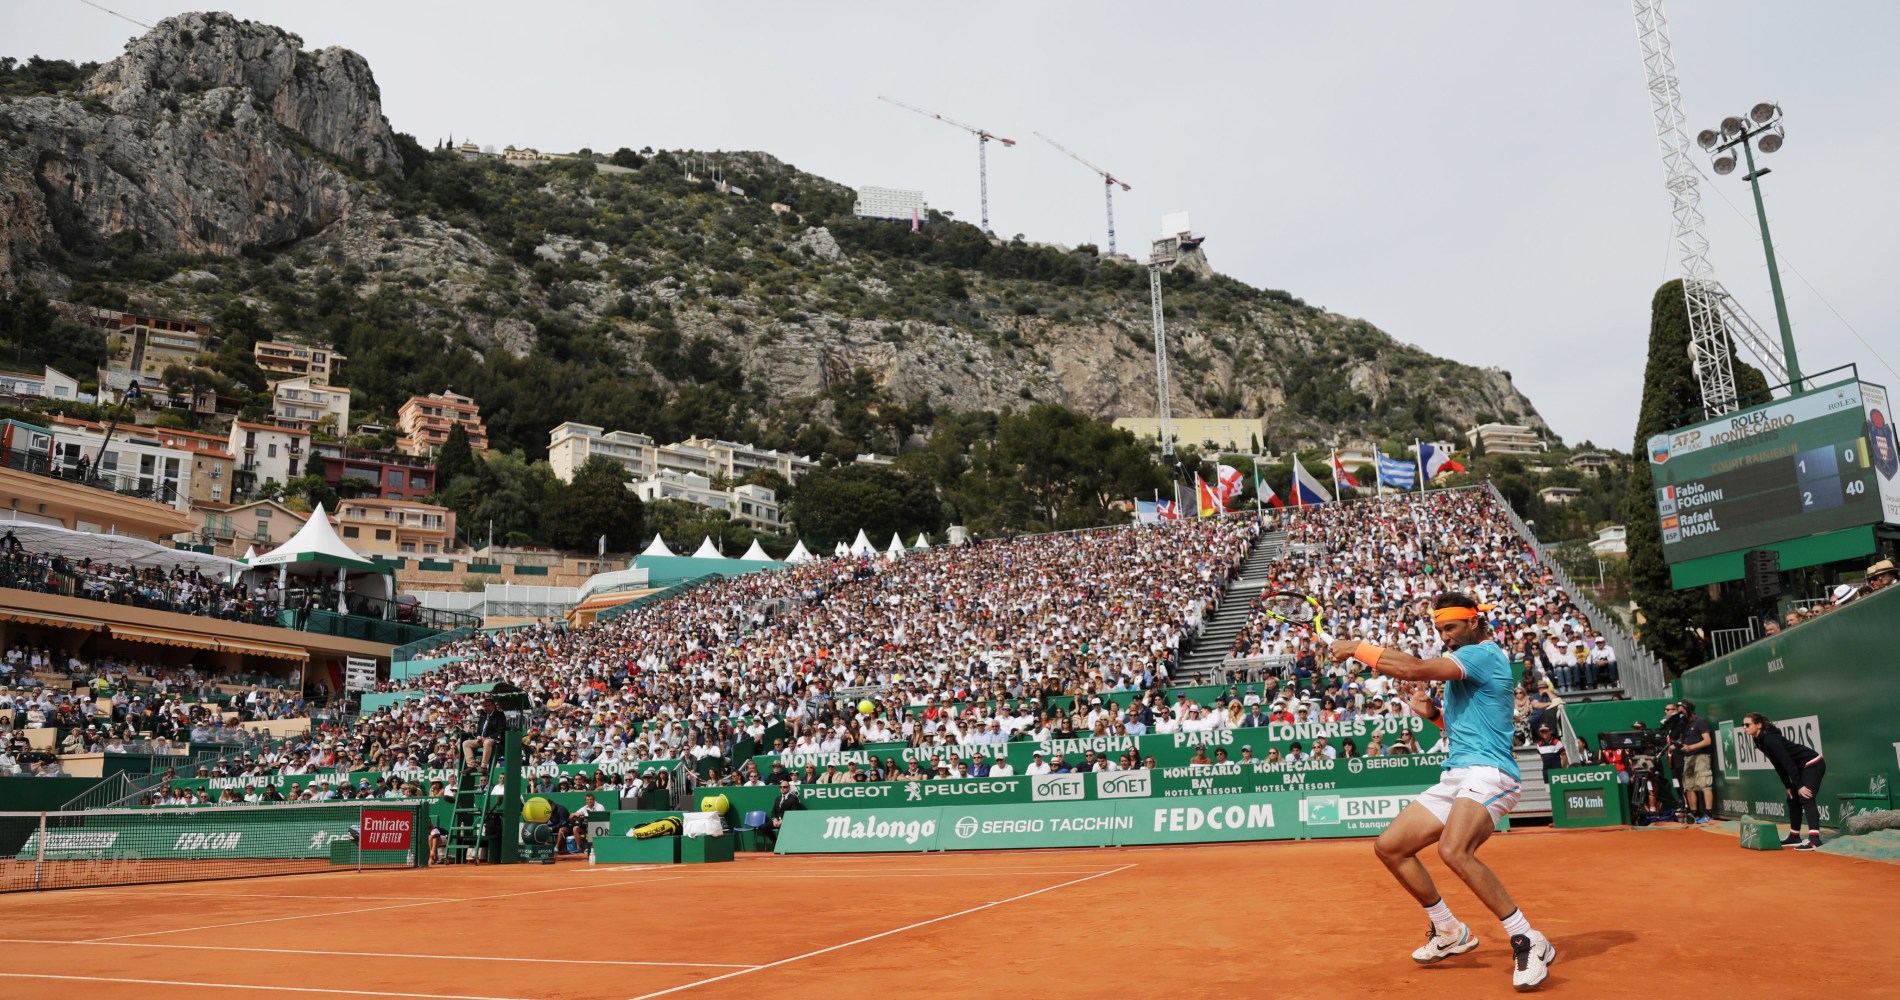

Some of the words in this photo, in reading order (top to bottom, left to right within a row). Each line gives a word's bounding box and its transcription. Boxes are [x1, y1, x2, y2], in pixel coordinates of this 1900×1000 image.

[1828, 397, 1857, 411] ROLEX
[1731, 410, 1769, 429] ROLEX
[1710, 413, 1795, 446] MONTE-CARLO
[1672, 430, 1701, 449] ATP
[1727, 430, 1779, 452] MASTERS
[1711, 456, 1744, 473] COURT
[1746, 445, 1787, 466] RAINIER
[1788, 443, 1798, 455] III
[1844, 449, 1854, 463] 0
[1798, 460, 1806, 473] 1
[1676, 483, 1705, 498] Fabio
[1846, 480, 1865, 496] 40
[1678, 489, 1723, 511] FOGNINI
[1803, 492, 1813, 506] 2
[1662, 503, 1673, 512] ITA
[1680, 508, 1713, 526] Rafael
[1666, 532, 1677, 541] ESP
[1682, 520, 1720, 539] NADAL
[1269, 719, 1367, 742] LONDRES
[1372, 716, 1424, 738] 2019
[1040, 735, 1140, 756] SHANGHAI
[1174, 730, 1234, 749] PARIS
[781, 750, 870, 768] MONTREAL
[902, 743, 1009, 763] CINCINNATI
[1253, 759, 1334, 774] MONTE-CARLO
[1366, 757, 1409, 769] SERGIO
[1412, 755, 1449, 767] TACC
[520, 765, 559, 778] ADRID
[1163, 765, 1242, 779] MONTE-CARLO
[1282, 772, 1306, 785] BAY
[1551, 770, 1613, 785] PEUGEOT
[209, 777, 248, 789] INDIAN
[249, 775, 284, 788] WELLS
[315, 773, 349, 786] MIAMI
[1191, 777, 1214, 790] BAY
[1255, 784, 1286, 792] HOTEL
[1288, 783, 1294, 791] &
[1297, 781, 1336, 791] RESORT
[803, 785, 891, 799] PEUGEOT
[924, 780, 1019, 796] PEUGEOT
[1164, 789, 1195, 797] HOTEL
[1197, 788, 1203, 796] &
[1205, 786, 1242, 795] RESORT
[1347, 799, 1391, 816] BNP
[1567, 796, 1585, 809] 150
[1586, 795, 1603, 808] kmh
[1755, 801, 1765, 814] BNP
[1765, 802, 1784, 817] PARIBAS
[364, 817, 410, 832] Emirates
[981, 819, 1044, 834] SERGIO
[1050, 815, 1133, 831] TACCHINI
[1154, 803, 1275, 832] FEDCOM
[1347, 821, 1357, 829] La
[823, 815, 937, 844] Malongo
[173, 832, 241, 850] FEDCOM
[369, 832, 382, 844] FLY
[383, 831, 402, 844] BETTER
